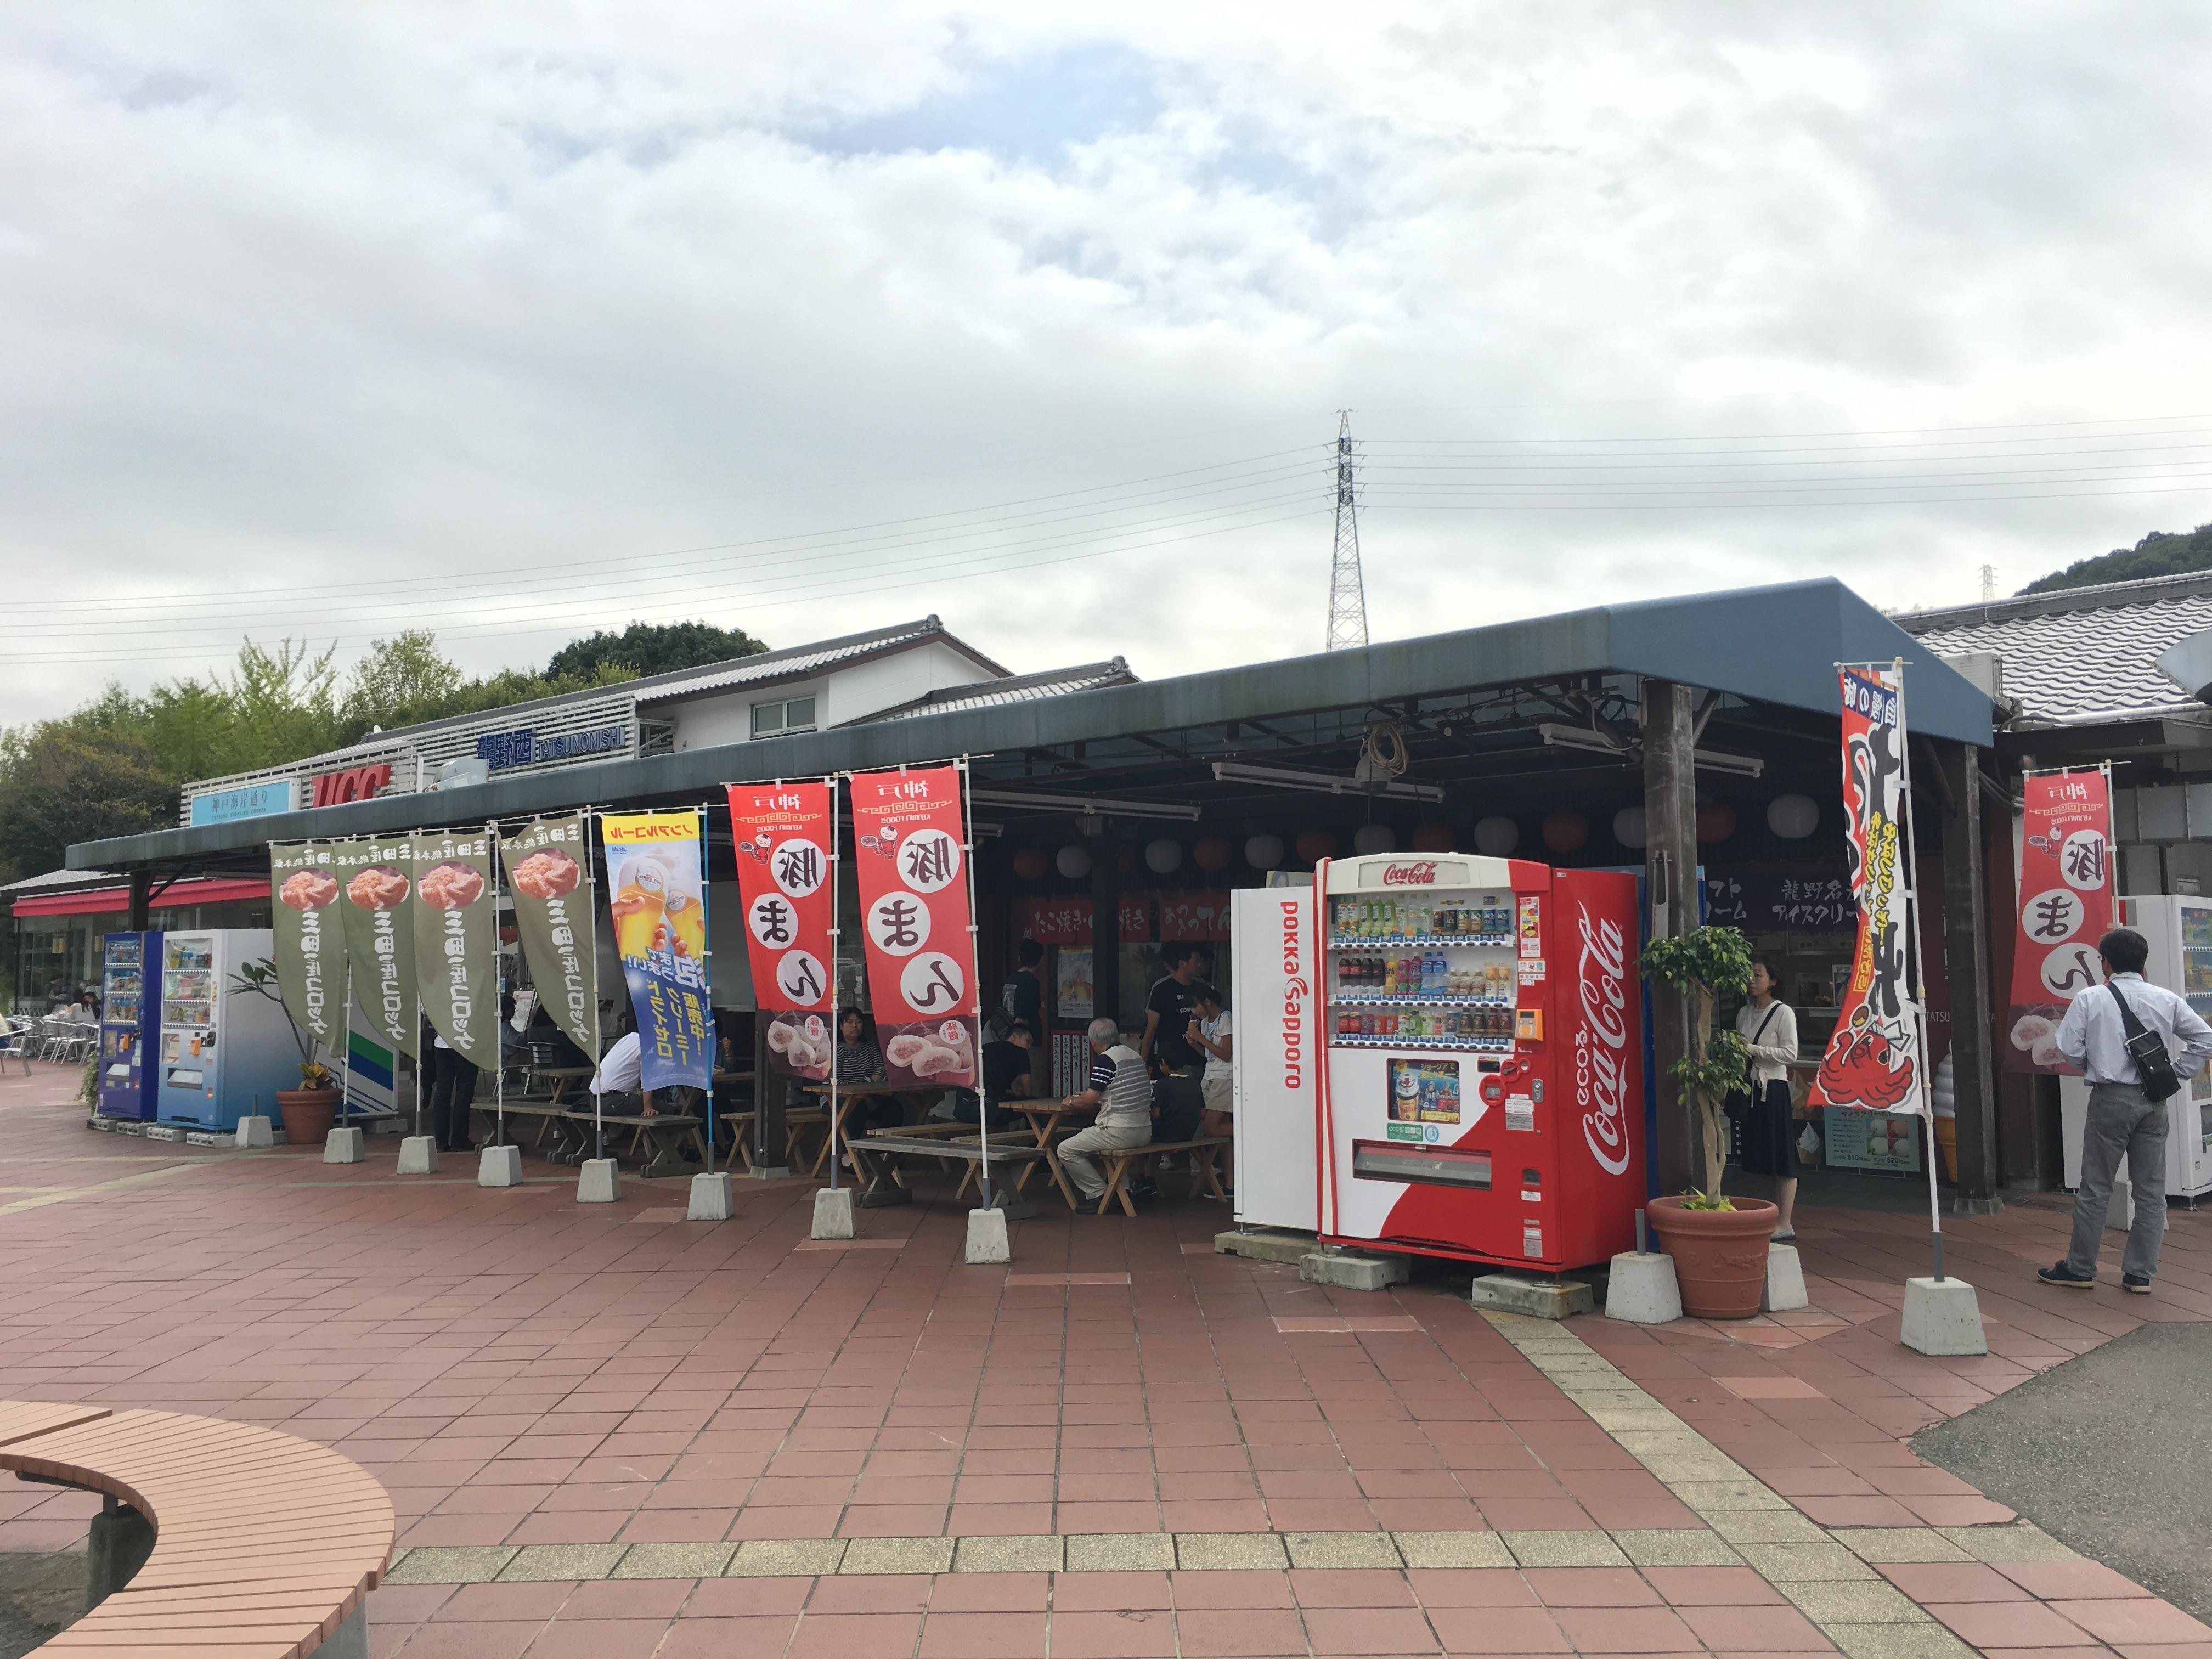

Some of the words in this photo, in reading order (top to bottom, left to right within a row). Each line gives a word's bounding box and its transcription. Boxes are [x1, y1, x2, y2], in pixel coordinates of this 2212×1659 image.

[537, 727, 624, 759] TATSUNONISHI
[311, 764, 391, 808] UCC
[212, 790, 267, 813] 神戸海岸通り
[1383, 862, 1438, 885] Coca-Cola
[1708, 878, 1741, 898] フト
[1578, 900, 1629, 1175] Coca-Cola
